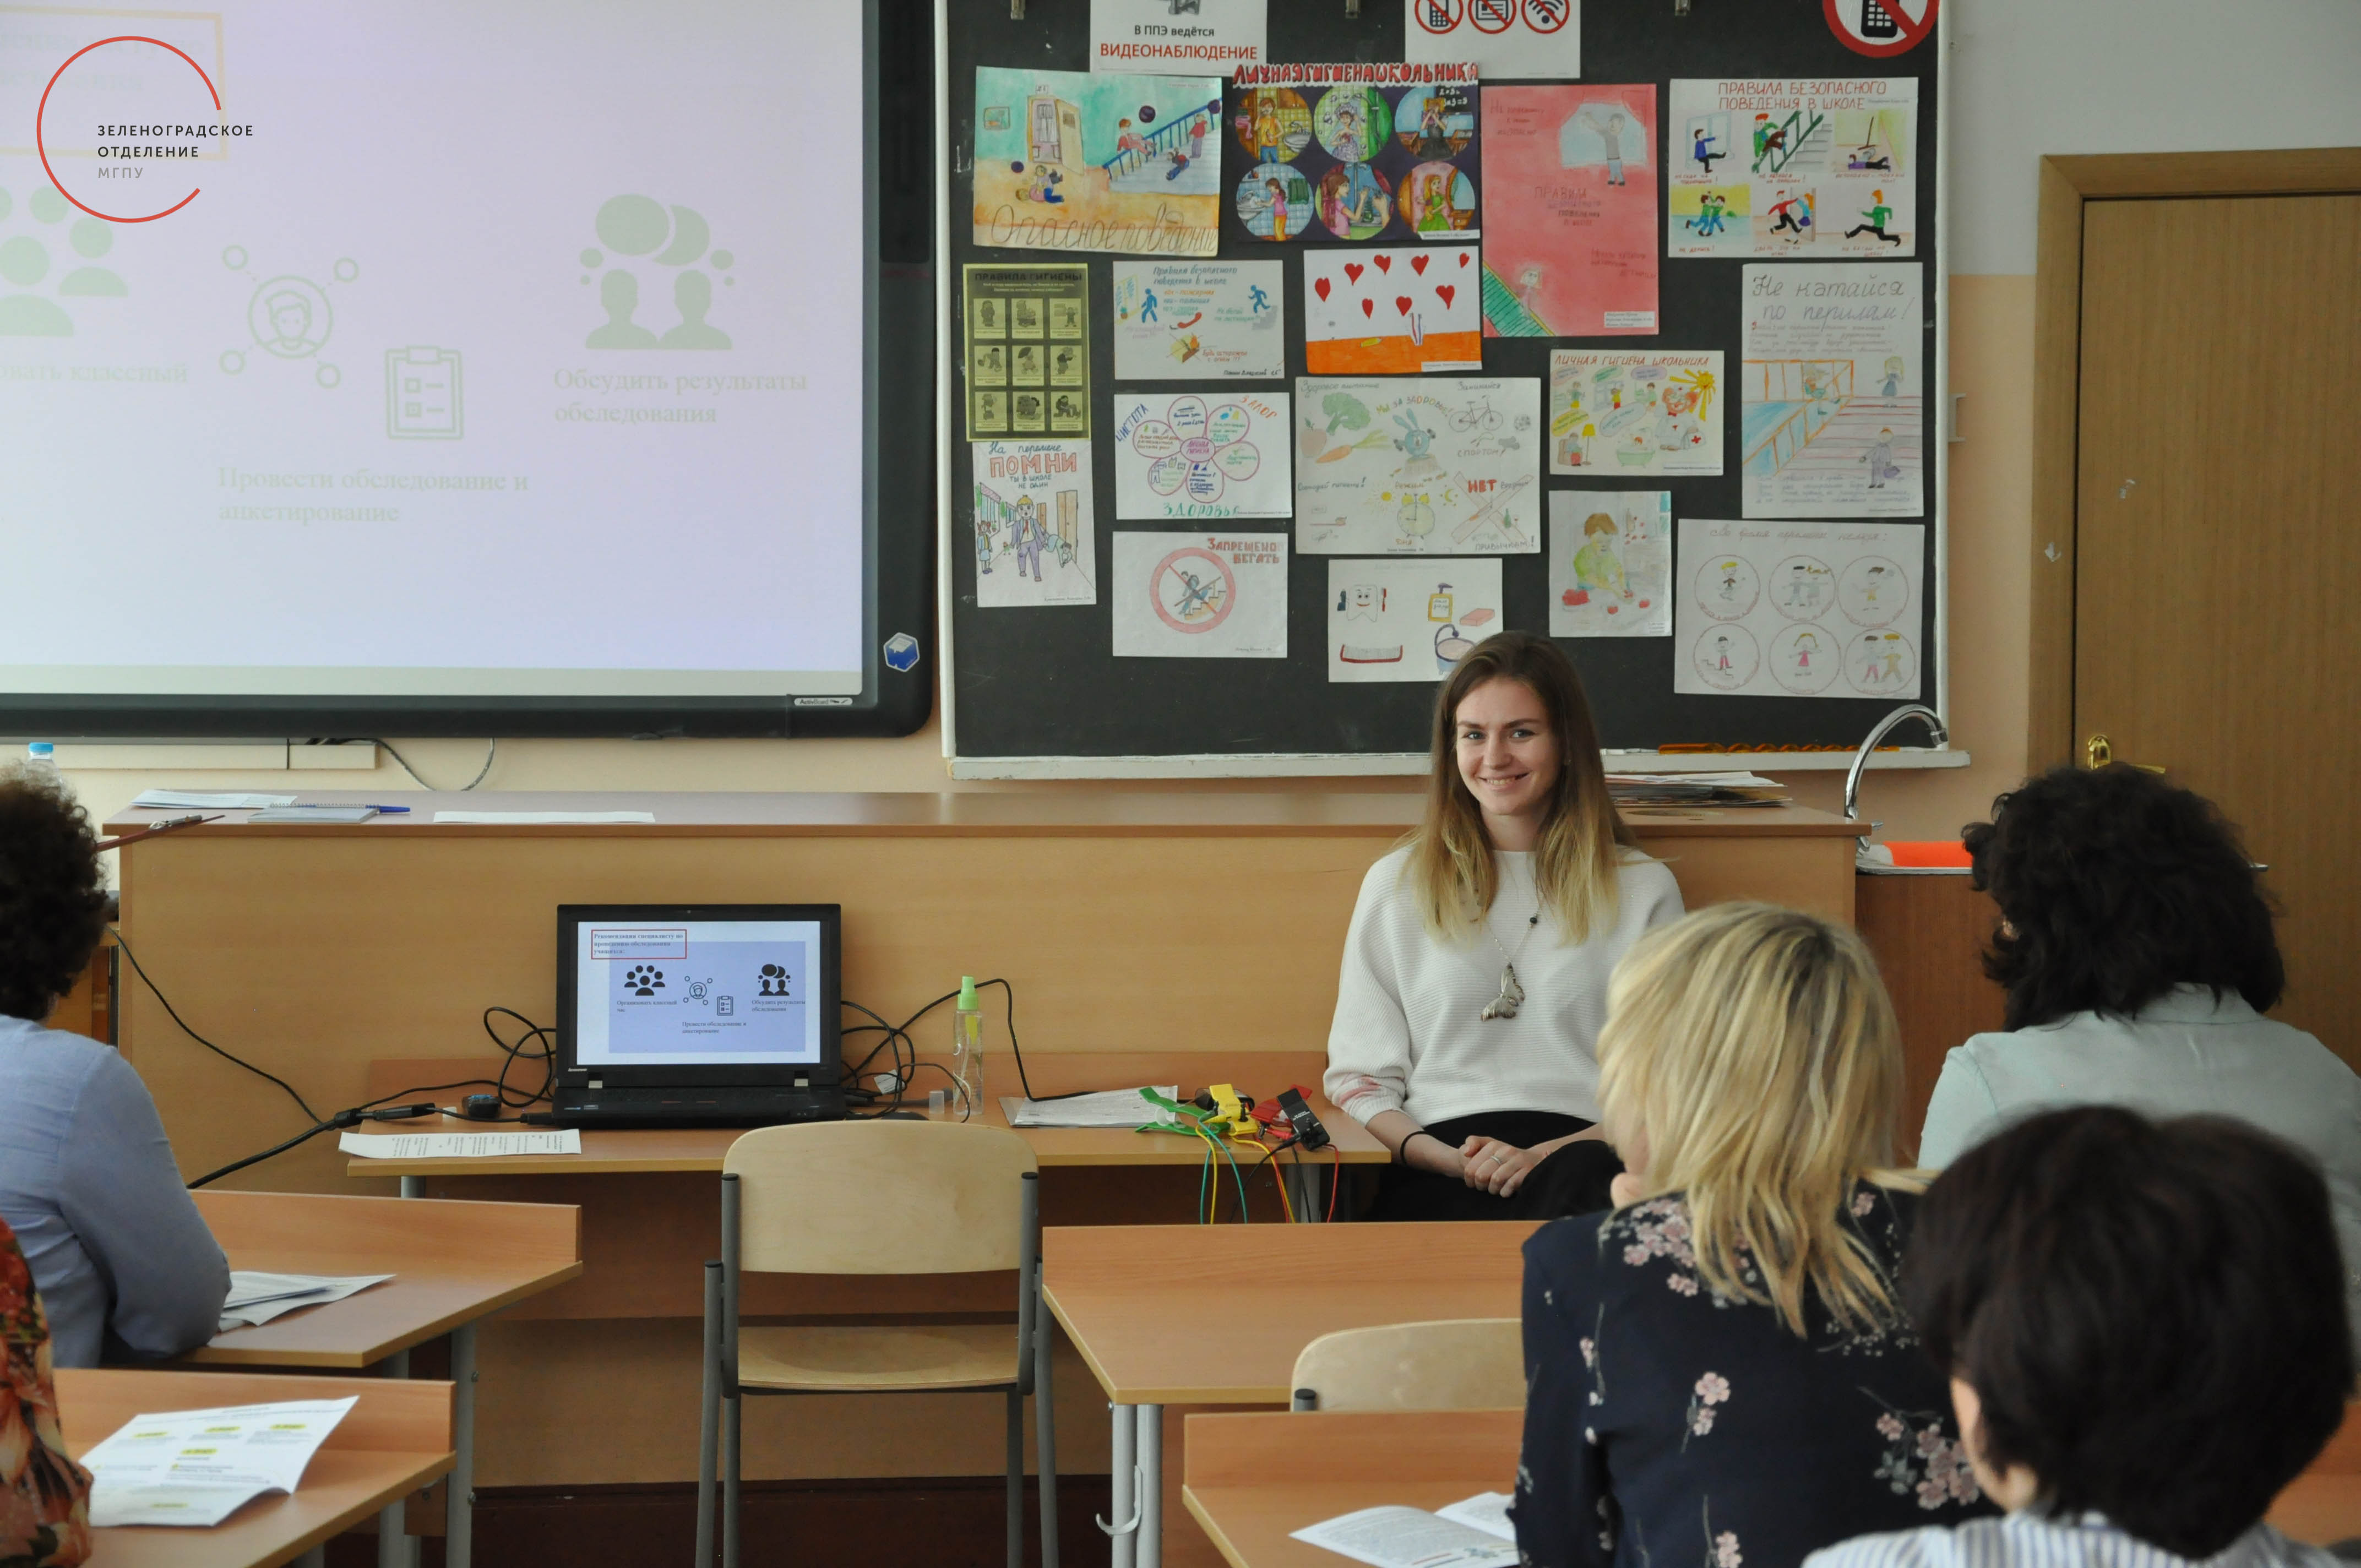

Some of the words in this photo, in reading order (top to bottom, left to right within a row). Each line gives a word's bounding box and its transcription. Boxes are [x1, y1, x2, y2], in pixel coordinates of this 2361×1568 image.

[1135, 25, 1141, 35] В
[1145, 25, 1168, 36] ППЭ
[1171, 25, 1215, 37] ведётся
[1101, 43, 1257, 61] ВИДЕОНАБЛЮДЕНИЕ
[1718, 81, 1783, 95] ПРАВИЛА
[1789, 81, 1887, 95] БЕЗОПАСНОГО
[1718, 96, 1799, 111] ПОВЕДЕНИЯ
[1808, 97, 1816, 110] В
[1823, 96, 1865, 111] ШКОЛЕ
[991, 204, 1120, 250] Опасное
[975, 273, 1026, 281] ПРАВИЛА
[1752, 274, 1784, 297] Не
[1795, 274, 1905, 297] катайся
[1762, 304, 1787, 319] по
[1554, 355, 1598, 366] ЛИЧНАЯ
[1602, 355, 1646, 366] ГИГИЕНА
[1652, 356, 1710, 367] ШКОЛЬНИКА
[69, 361, 189, 383] классный
[554, 366, 668, 395] Обсудить
[674, 373, 807, 395] результаты
[554, 402, 718, 425] обследования
[1114, 402, 1151, 443] ЧИСТОТА
[988, 440, 1007, 454] На
[1018, 444, 1062, 458] перемене
[989, 452, 1077, 478] ПОМНИ
[218, 466, 334, 493] Провести
[341, 467, 508, 492] обследование
[514, 474, 529, 491] и
[1467, 478, 1498, 493] НЕТ
[218, 503, 400, 527] анкетирование
[1233, 553, 1281, 564] БЕГАТЬ
